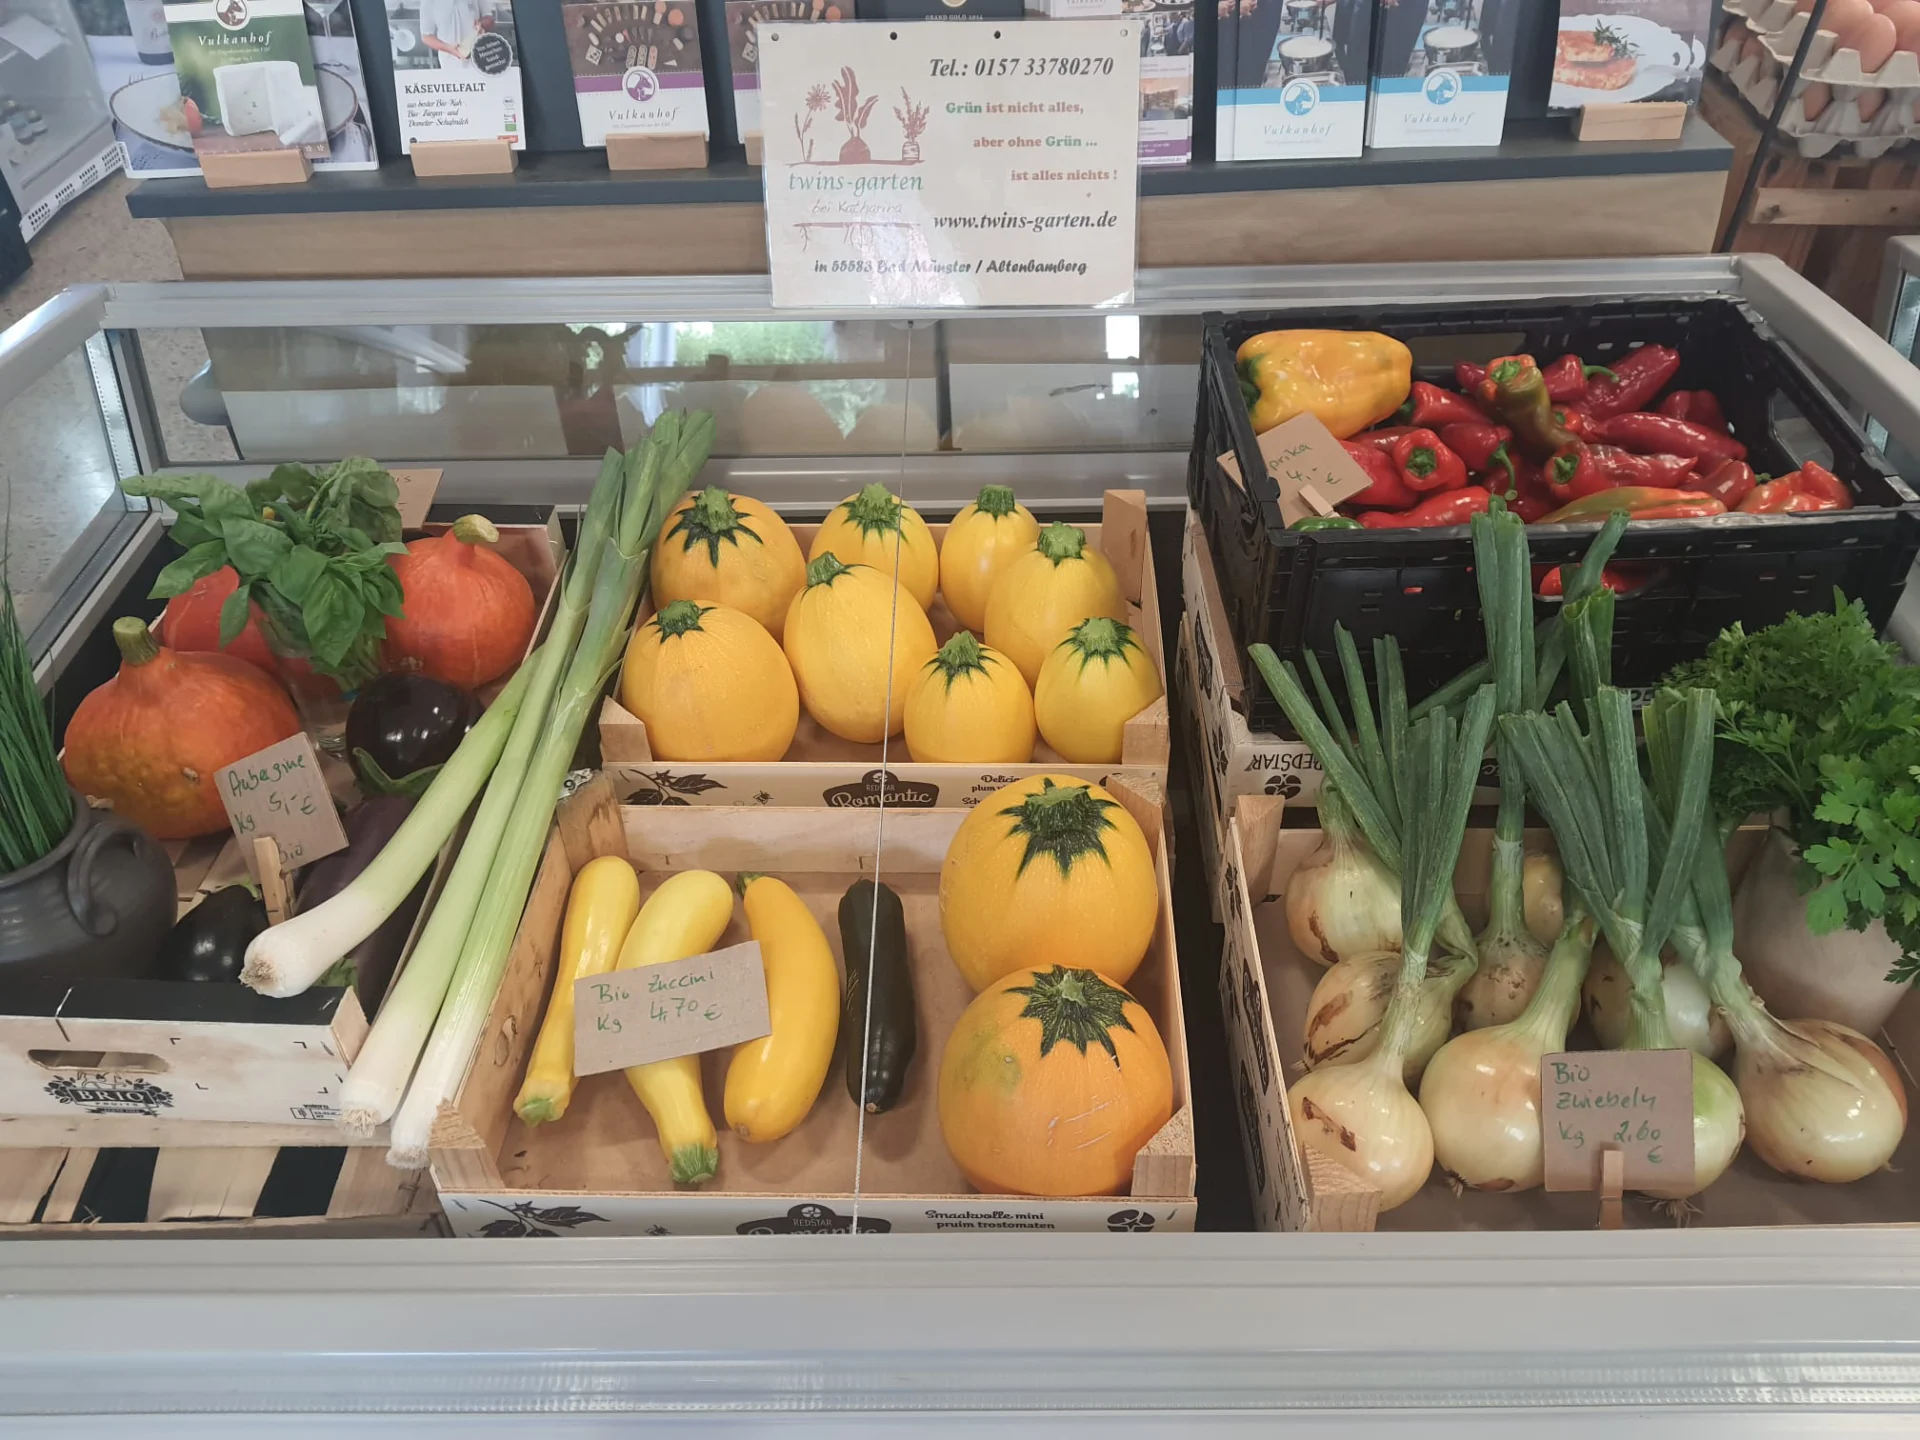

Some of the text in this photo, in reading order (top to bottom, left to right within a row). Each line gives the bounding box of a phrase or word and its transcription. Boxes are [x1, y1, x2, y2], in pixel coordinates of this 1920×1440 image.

[198, 30, 273, 46] Vulkanhof
[930, 57, 1114, 76] Tel.: 0157 33780270
[404, 82, 486, 94] KÄSEVIELFALT
[609, 105, 680, 121] Vulkanhof
[945, 100, 1084, 116] Grün ist nicht alles,
[1403, 112, 1475, 124] Vulkanhof
[1263, 123, 1333, 136] Vulkanhof
[973, 136, 1004, 148] aber
[1008, 136, 1041, 148] ohne
[1045, 135, 1082, 147] Grün
[1011, 170, 1028, 181] ist
[1032, 170, 1063, 181] alles
[1066, 169, 1109, 180] nichts
[789, 171, 924, 197] twins-garten
[812, 200, 831, 214] bei
[934, 210, 1117, 232] www.twins-garten.de
[814, 260, 828, 273] in
[832, 260, 872, 273] 55583
[986, 259, 1087, 276] Altenbamberg
[981, 775, 1023, 783] Delicio
[971, 785, 996, 793] plum
[591, 984, 630, 1004] Bio
[1551, 1062, 1590, 1084] Bio
[78, 1090, 144, 1101] BRIO
[925, 1210, 1013, 1219] Smaakvolle
[793, 1219, 832, 1227] REDSTAR
[936, 1221, 1055, 1229] pruim trostomaten
